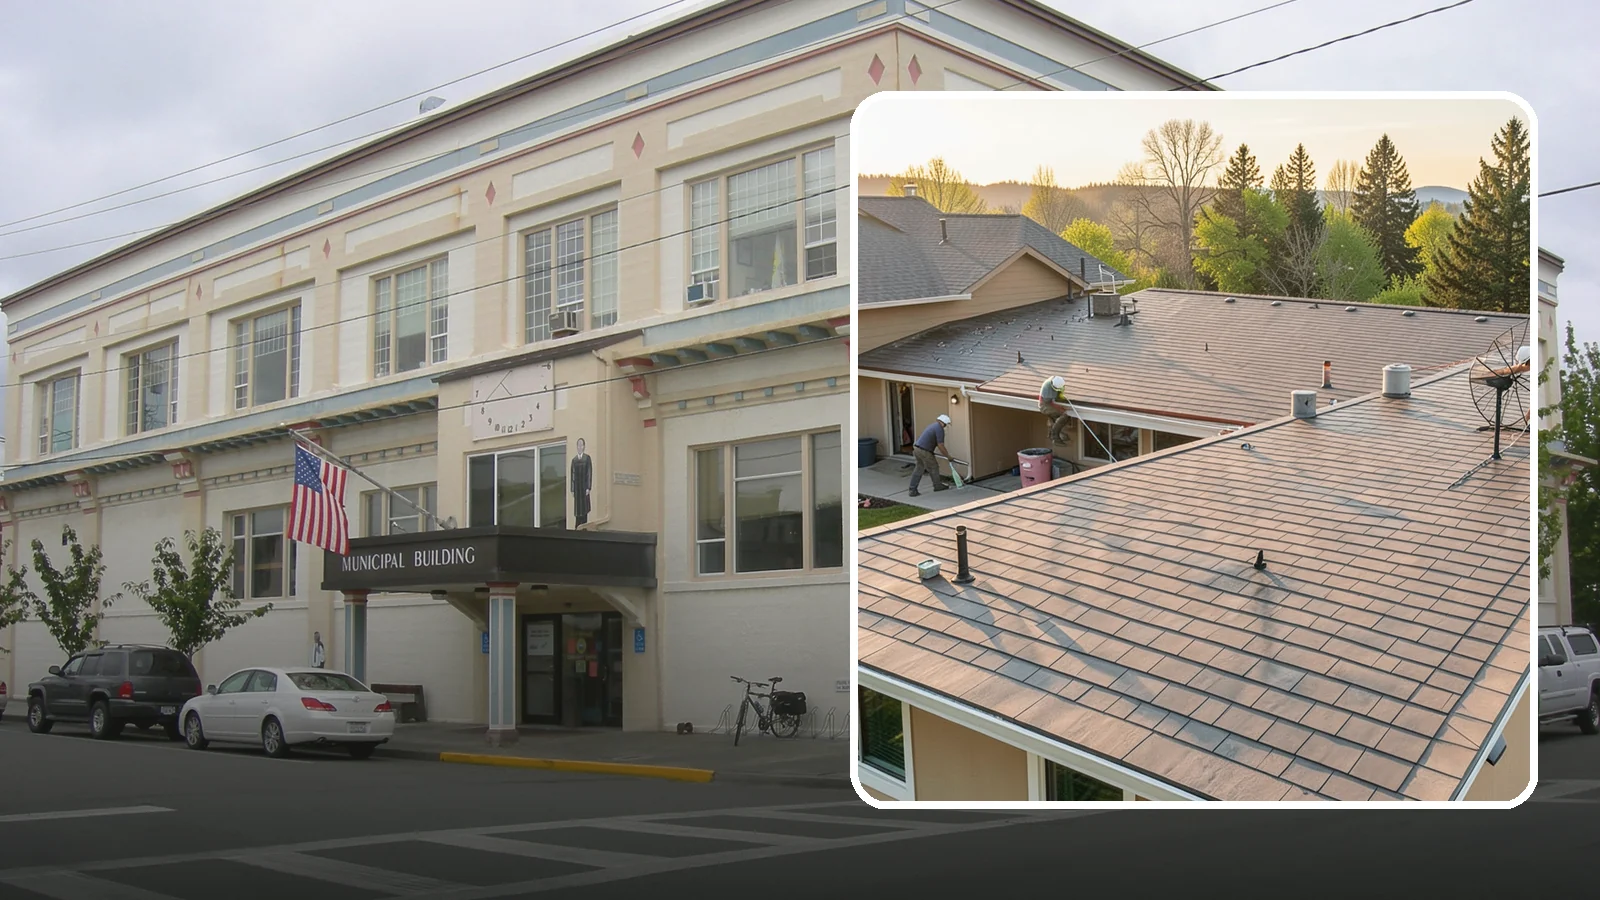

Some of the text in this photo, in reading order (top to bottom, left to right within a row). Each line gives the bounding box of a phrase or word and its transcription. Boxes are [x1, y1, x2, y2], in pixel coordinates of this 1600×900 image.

[536, 402, 540, 410] 4
[480, 407, 485, 415] 8
[487, 417, 492, 426] 9
[528, 414, 533, 422] 3
[494, 423, 500, 432] 10
[520, 420, 525, 428] 2
[501, 425, 506, 433] 11
[507, 425, 513, 433] 12
[342, 546, 475, 571] MUNICIPAL BUILDING
